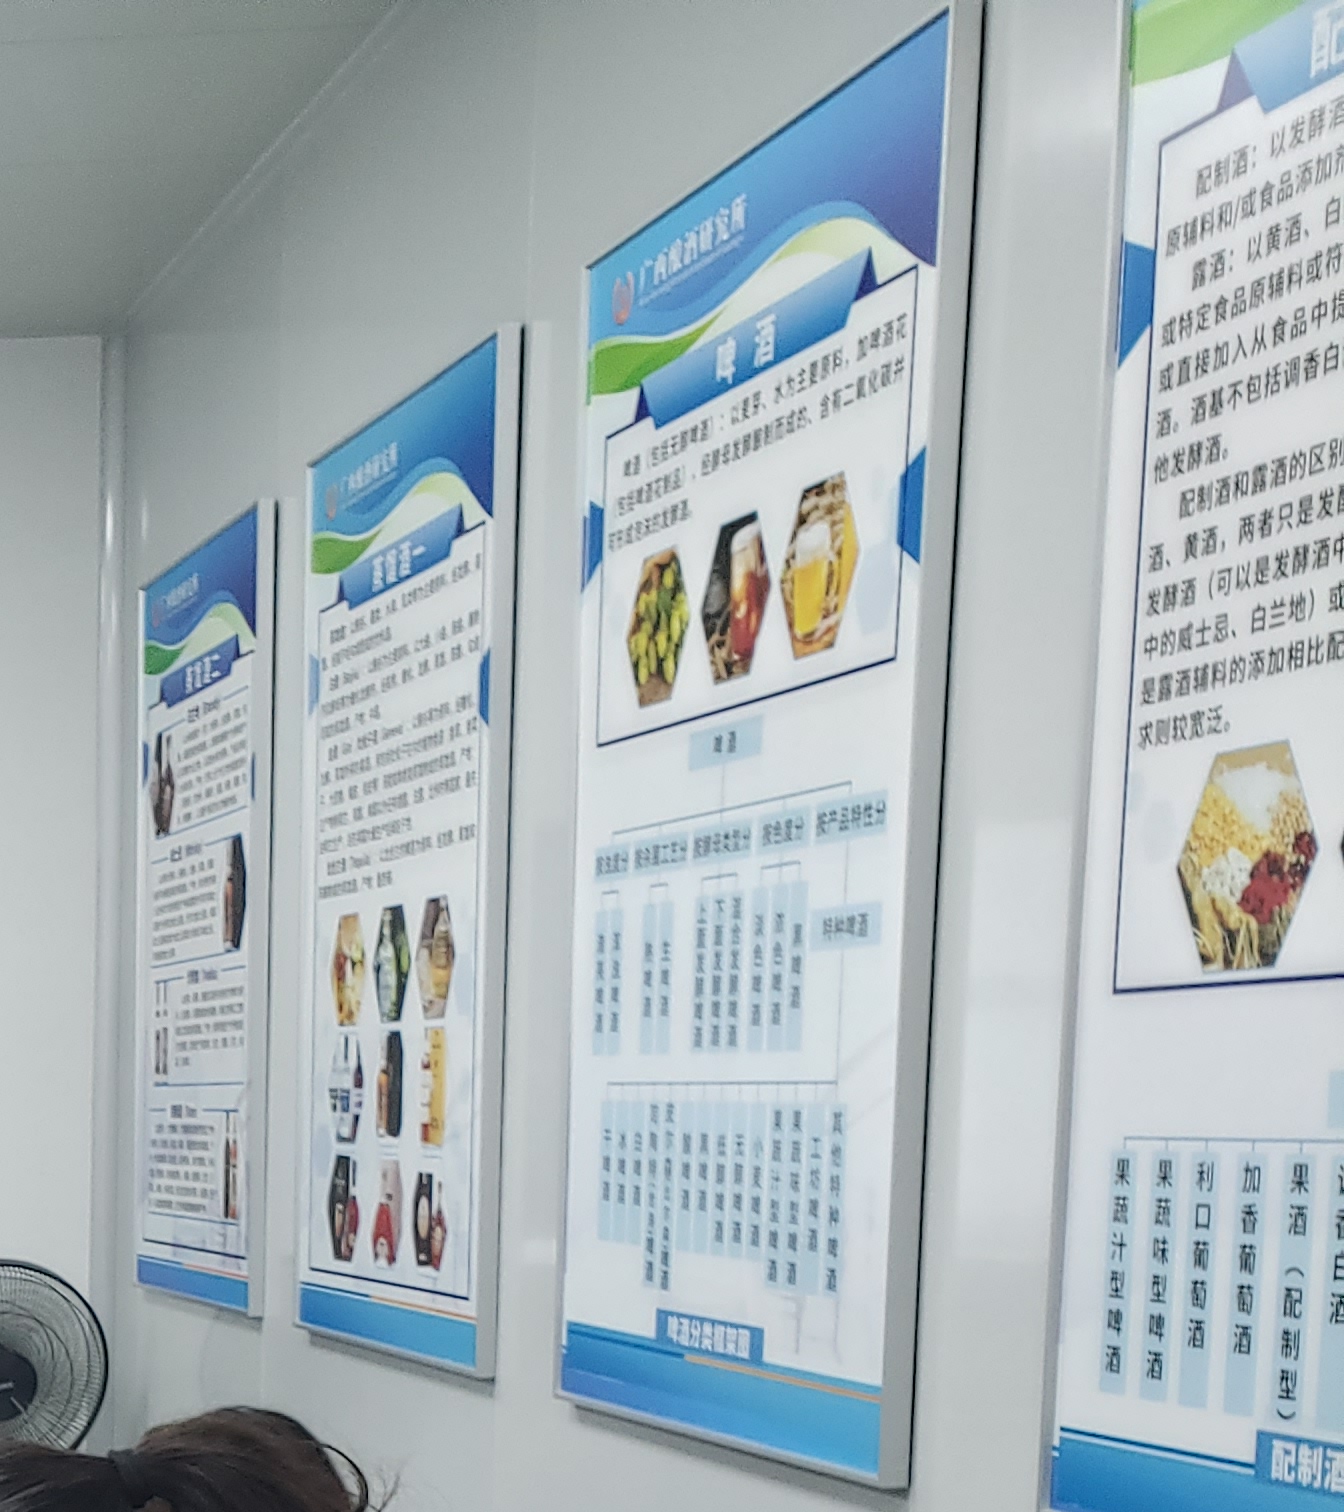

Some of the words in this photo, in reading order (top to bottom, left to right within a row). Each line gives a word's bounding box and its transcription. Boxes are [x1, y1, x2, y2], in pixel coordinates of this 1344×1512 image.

[1154, 433, 1229, 484] 他发酵酒。
[1137, 704, 1231, 750] 求则较宽泛。
[1105, 1157, 1132, 1375] 果蔬汁型啤酒
[1146, 1159, 1174, 1382] 果蔬味型啤酒
[1187, 1160, 1215, 1350] 利口葡萄酒
[1233, 1161, 1262, 1356] 加香葡萄酒
